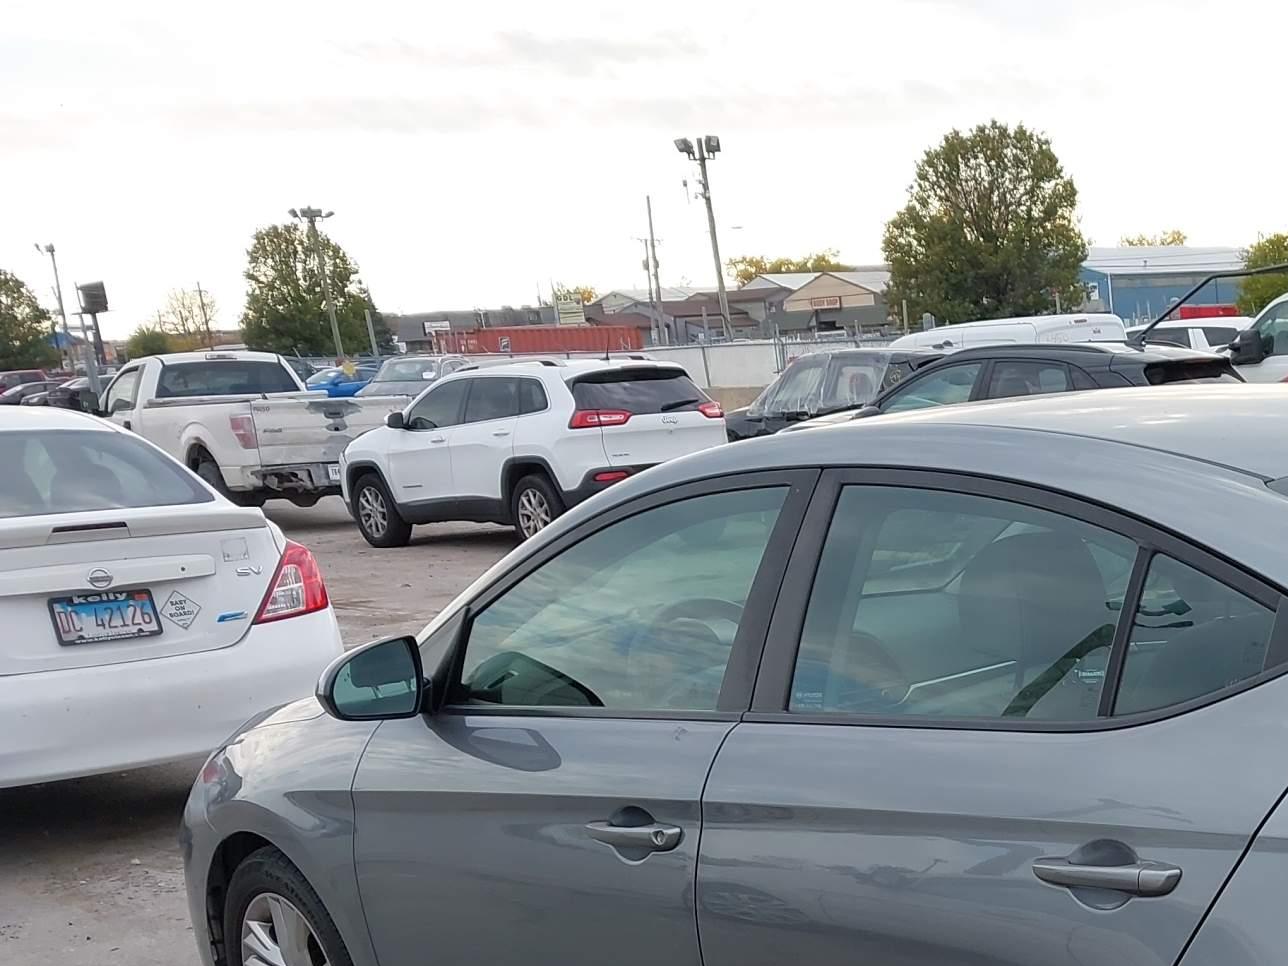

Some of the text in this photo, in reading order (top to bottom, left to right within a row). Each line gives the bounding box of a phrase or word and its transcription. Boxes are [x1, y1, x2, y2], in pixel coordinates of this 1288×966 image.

[235, 565, 263, 577] SV
[72, 590, 128, 604] kelly
[169, 599, 187, 607] BABY
[56, 602, 152, 634] DC 42126
